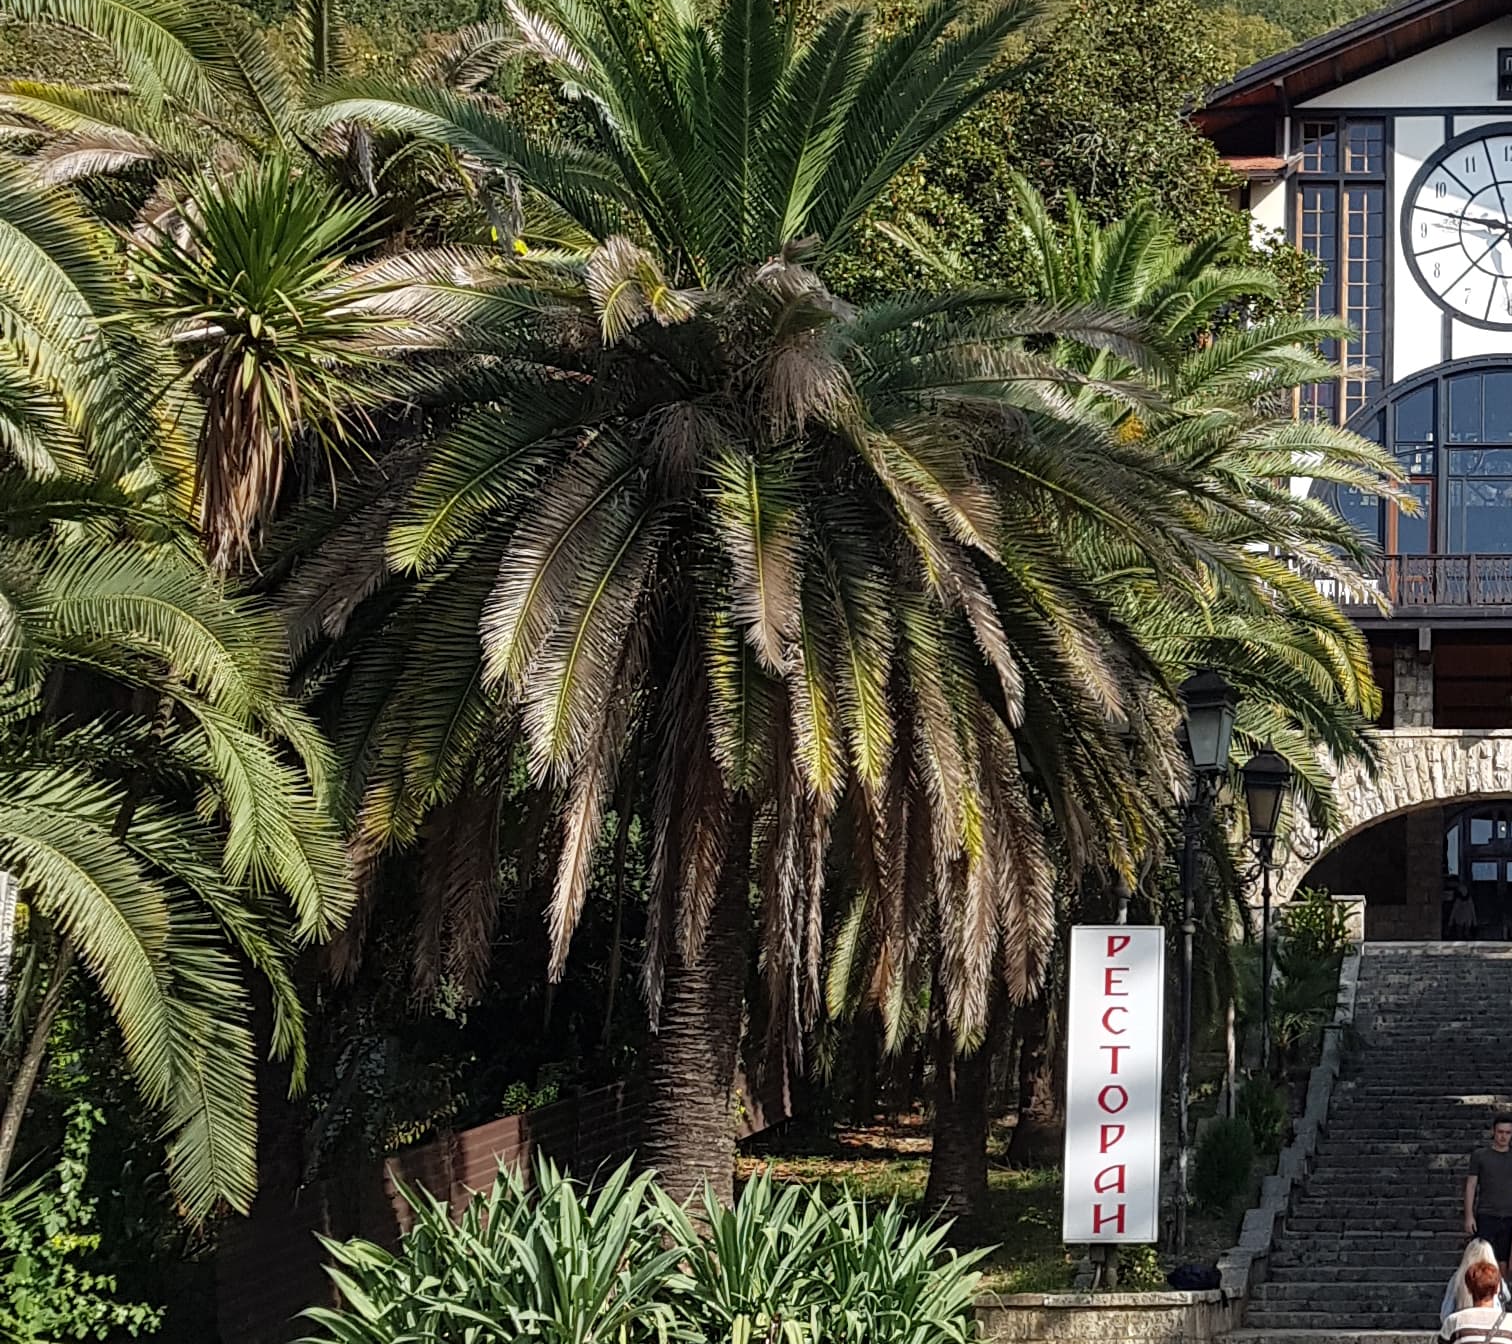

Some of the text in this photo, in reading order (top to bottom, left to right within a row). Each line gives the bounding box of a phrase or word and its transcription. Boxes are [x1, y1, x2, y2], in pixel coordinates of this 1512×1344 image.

[1465, 156, 1476, 173] 11
[1435, 181, 1447, 199] 10
[1420, 222, 1428, 239] 9
[1433, 262, 1441, 278] 8
[1464, 287, 1472, 304] 7
[1092, 935, 1131, 1234] РЕСТОРАН
